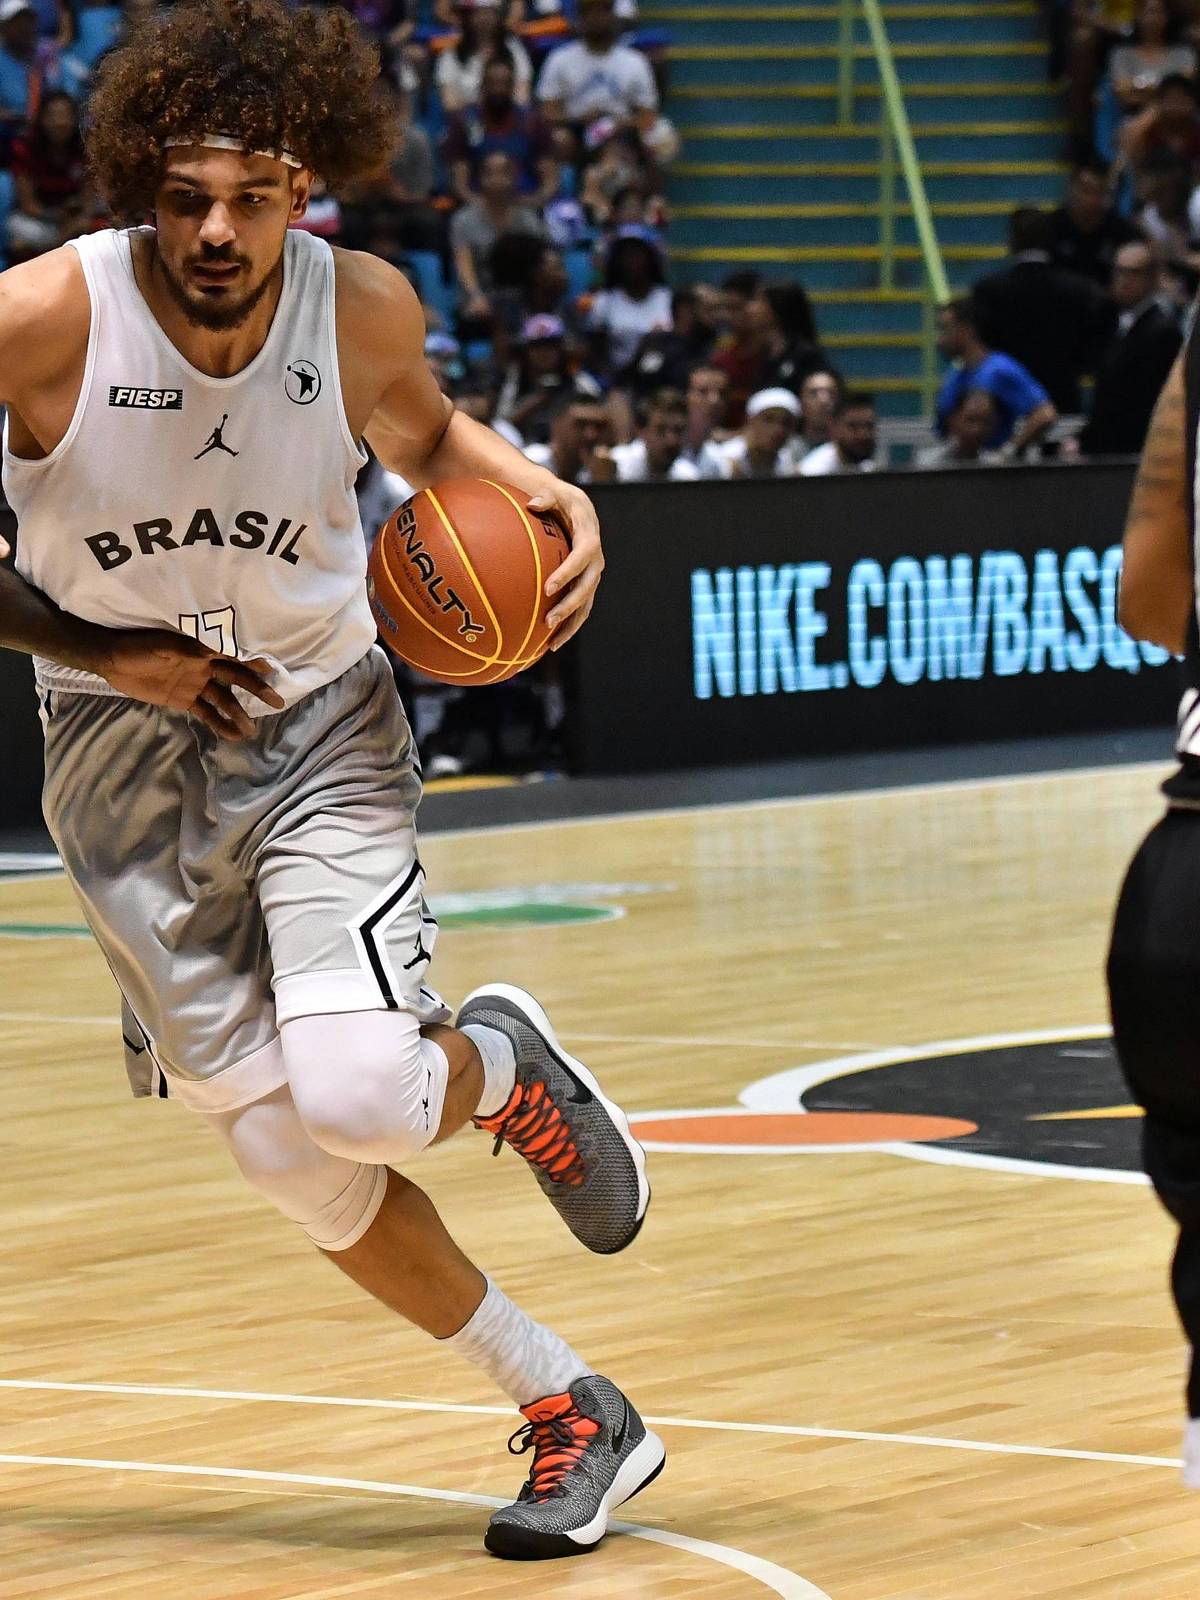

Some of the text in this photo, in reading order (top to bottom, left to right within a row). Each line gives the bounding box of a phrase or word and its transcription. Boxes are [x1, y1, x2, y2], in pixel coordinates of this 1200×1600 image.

[114, 388, 179, 408] FIESP
[84, 508, 307, 571] BRASIL
[690, 544, 1185, 700] NIKE.COM/BASQ
